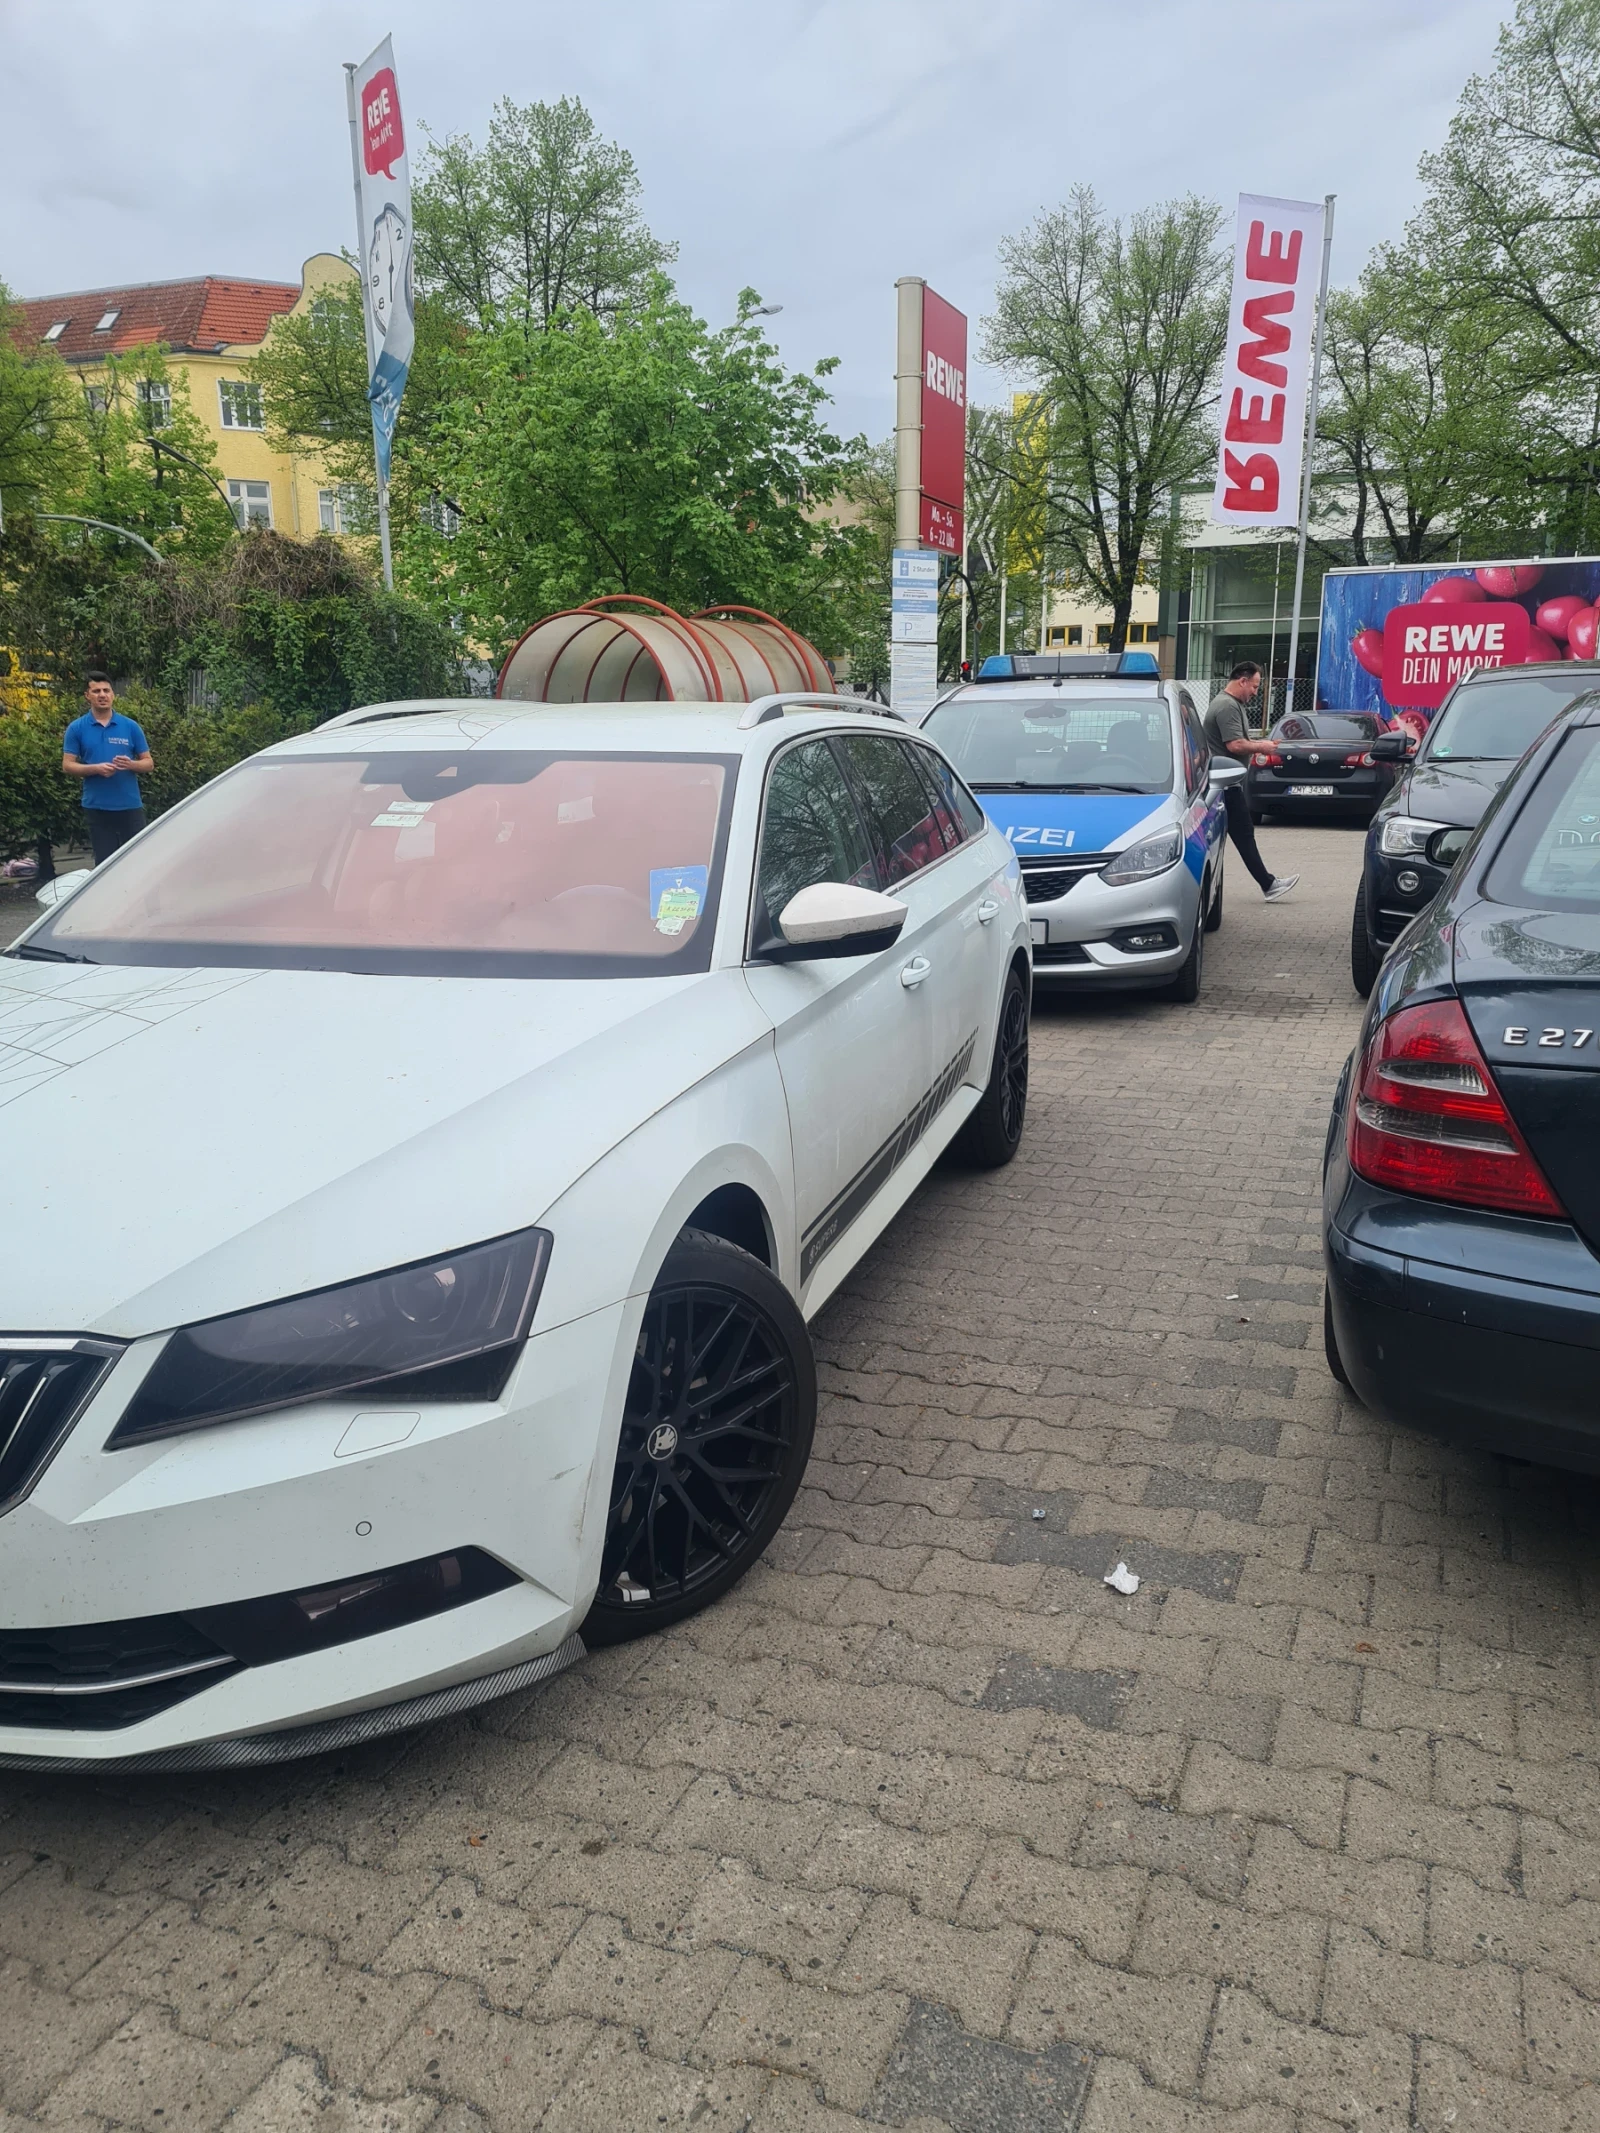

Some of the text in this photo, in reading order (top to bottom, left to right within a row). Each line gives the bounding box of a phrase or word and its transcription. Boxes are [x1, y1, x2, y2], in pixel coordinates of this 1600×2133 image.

[927, 350, 964, 407] REWE
[1404, 623, 1505, 653] REWE
[1402, 657, 1441, 684] DEIN
[1005, 826, 1076, 848] IZEI
[1503, 1026, 1600, 1049] E 27
